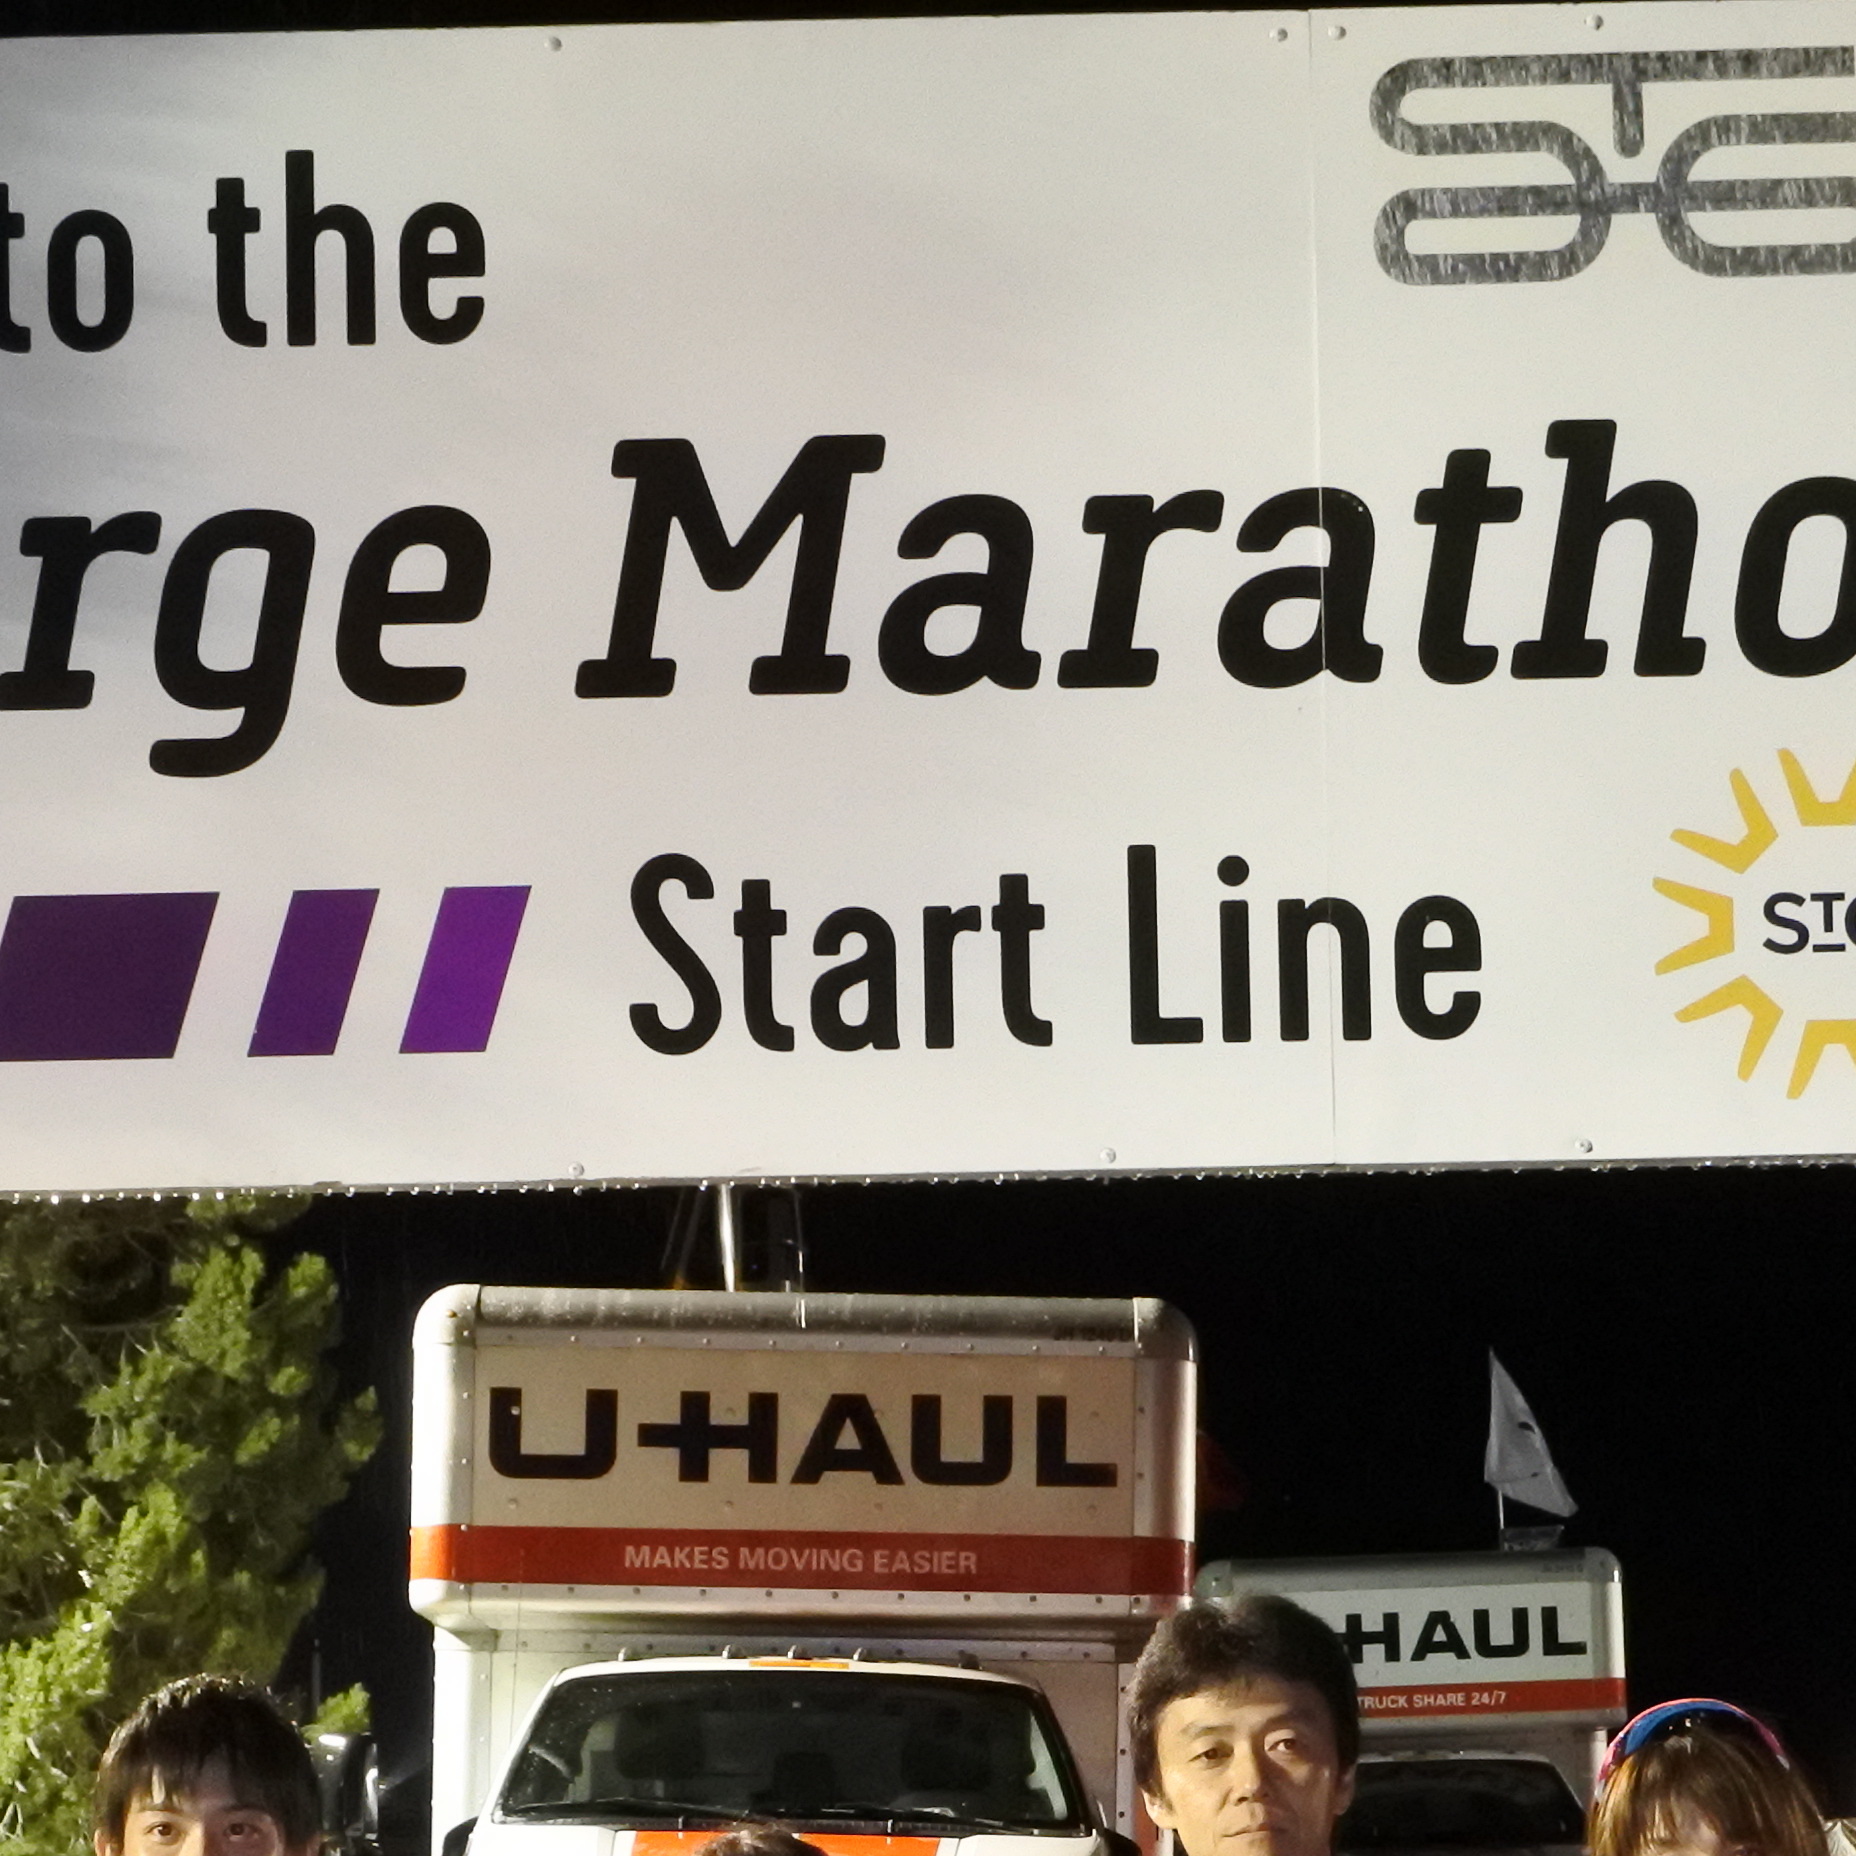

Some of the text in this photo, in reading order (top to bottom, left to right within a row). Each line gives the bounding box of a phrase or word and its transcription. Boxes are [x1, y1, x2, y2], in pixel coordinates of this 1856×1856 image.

[207, 149, 486, 348] the
[629, 844, 1482, 1056] Start Line
[489, 1386, 1119, 1489] U-HAUL
[624, 1545, 978, 1575] MAKES MOVING EASIER
[1357, 1691, 1507, 1709] TRUCK SHARE 24/7
